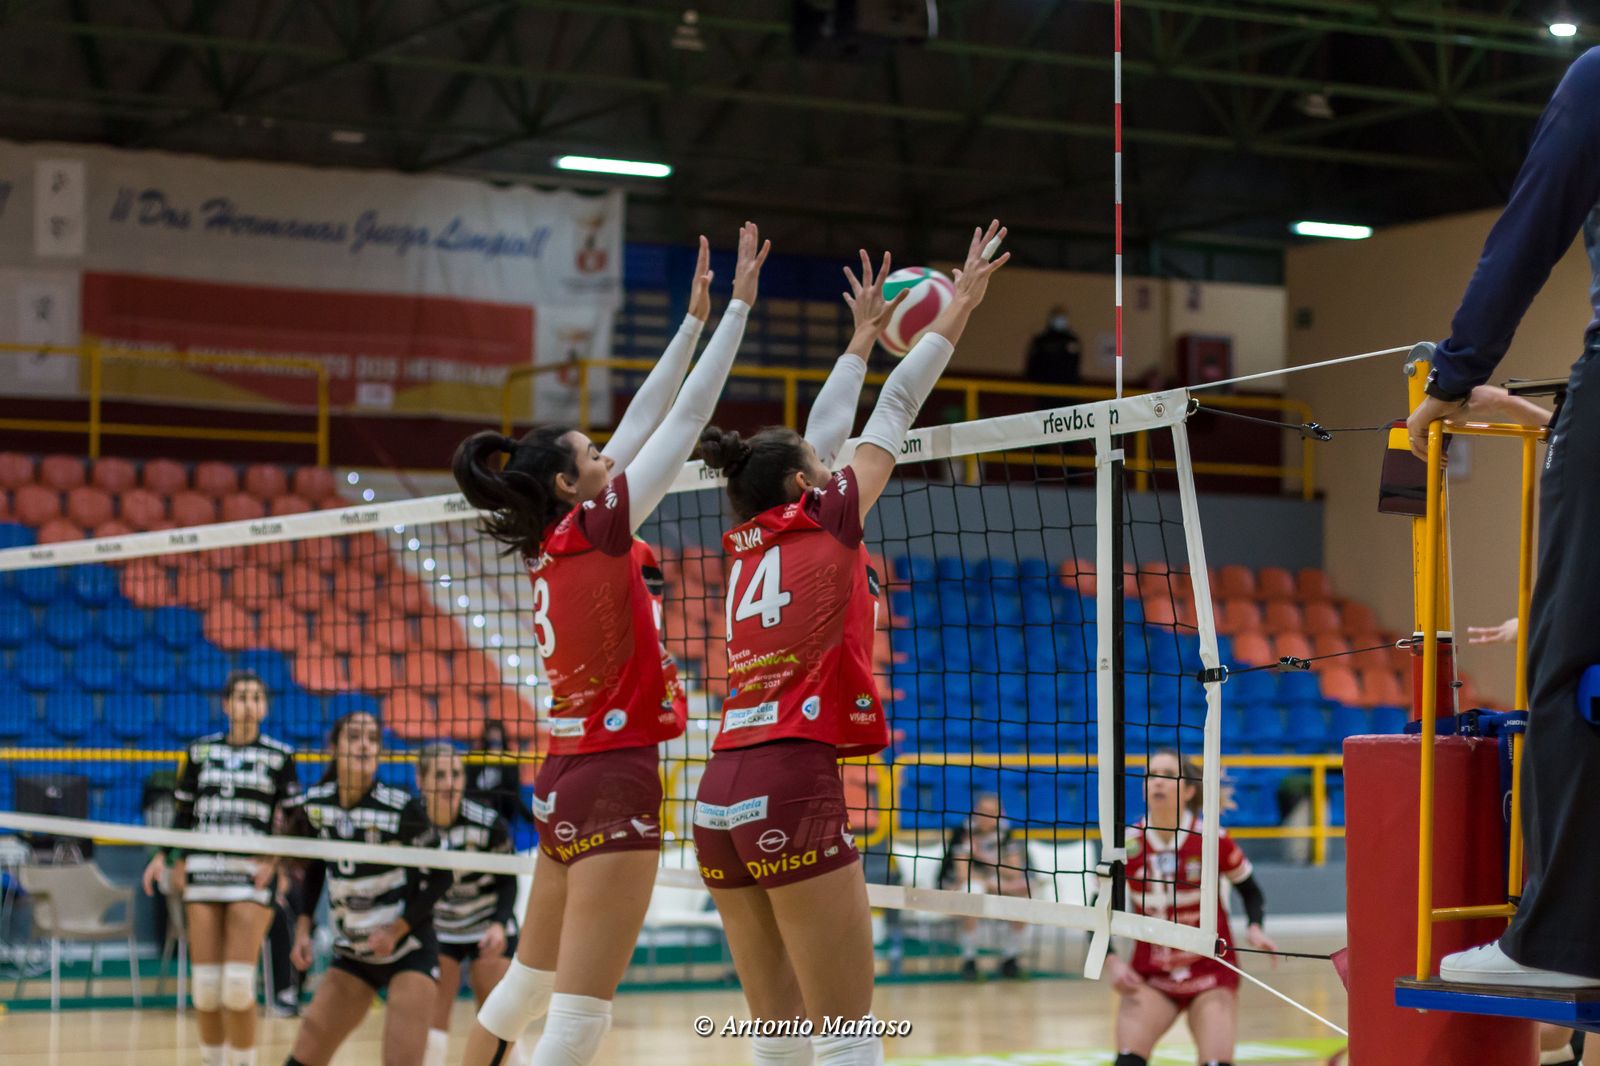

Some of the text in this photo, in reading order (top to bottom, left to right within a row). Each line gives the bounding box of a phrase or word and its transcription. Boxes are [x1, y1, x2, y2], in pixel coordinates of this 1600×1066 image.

[1042, 408, 1119, 435] rfevb.cm
[725, 545, 791, 642] 14
[746, 850, 817, 880] Divisa
